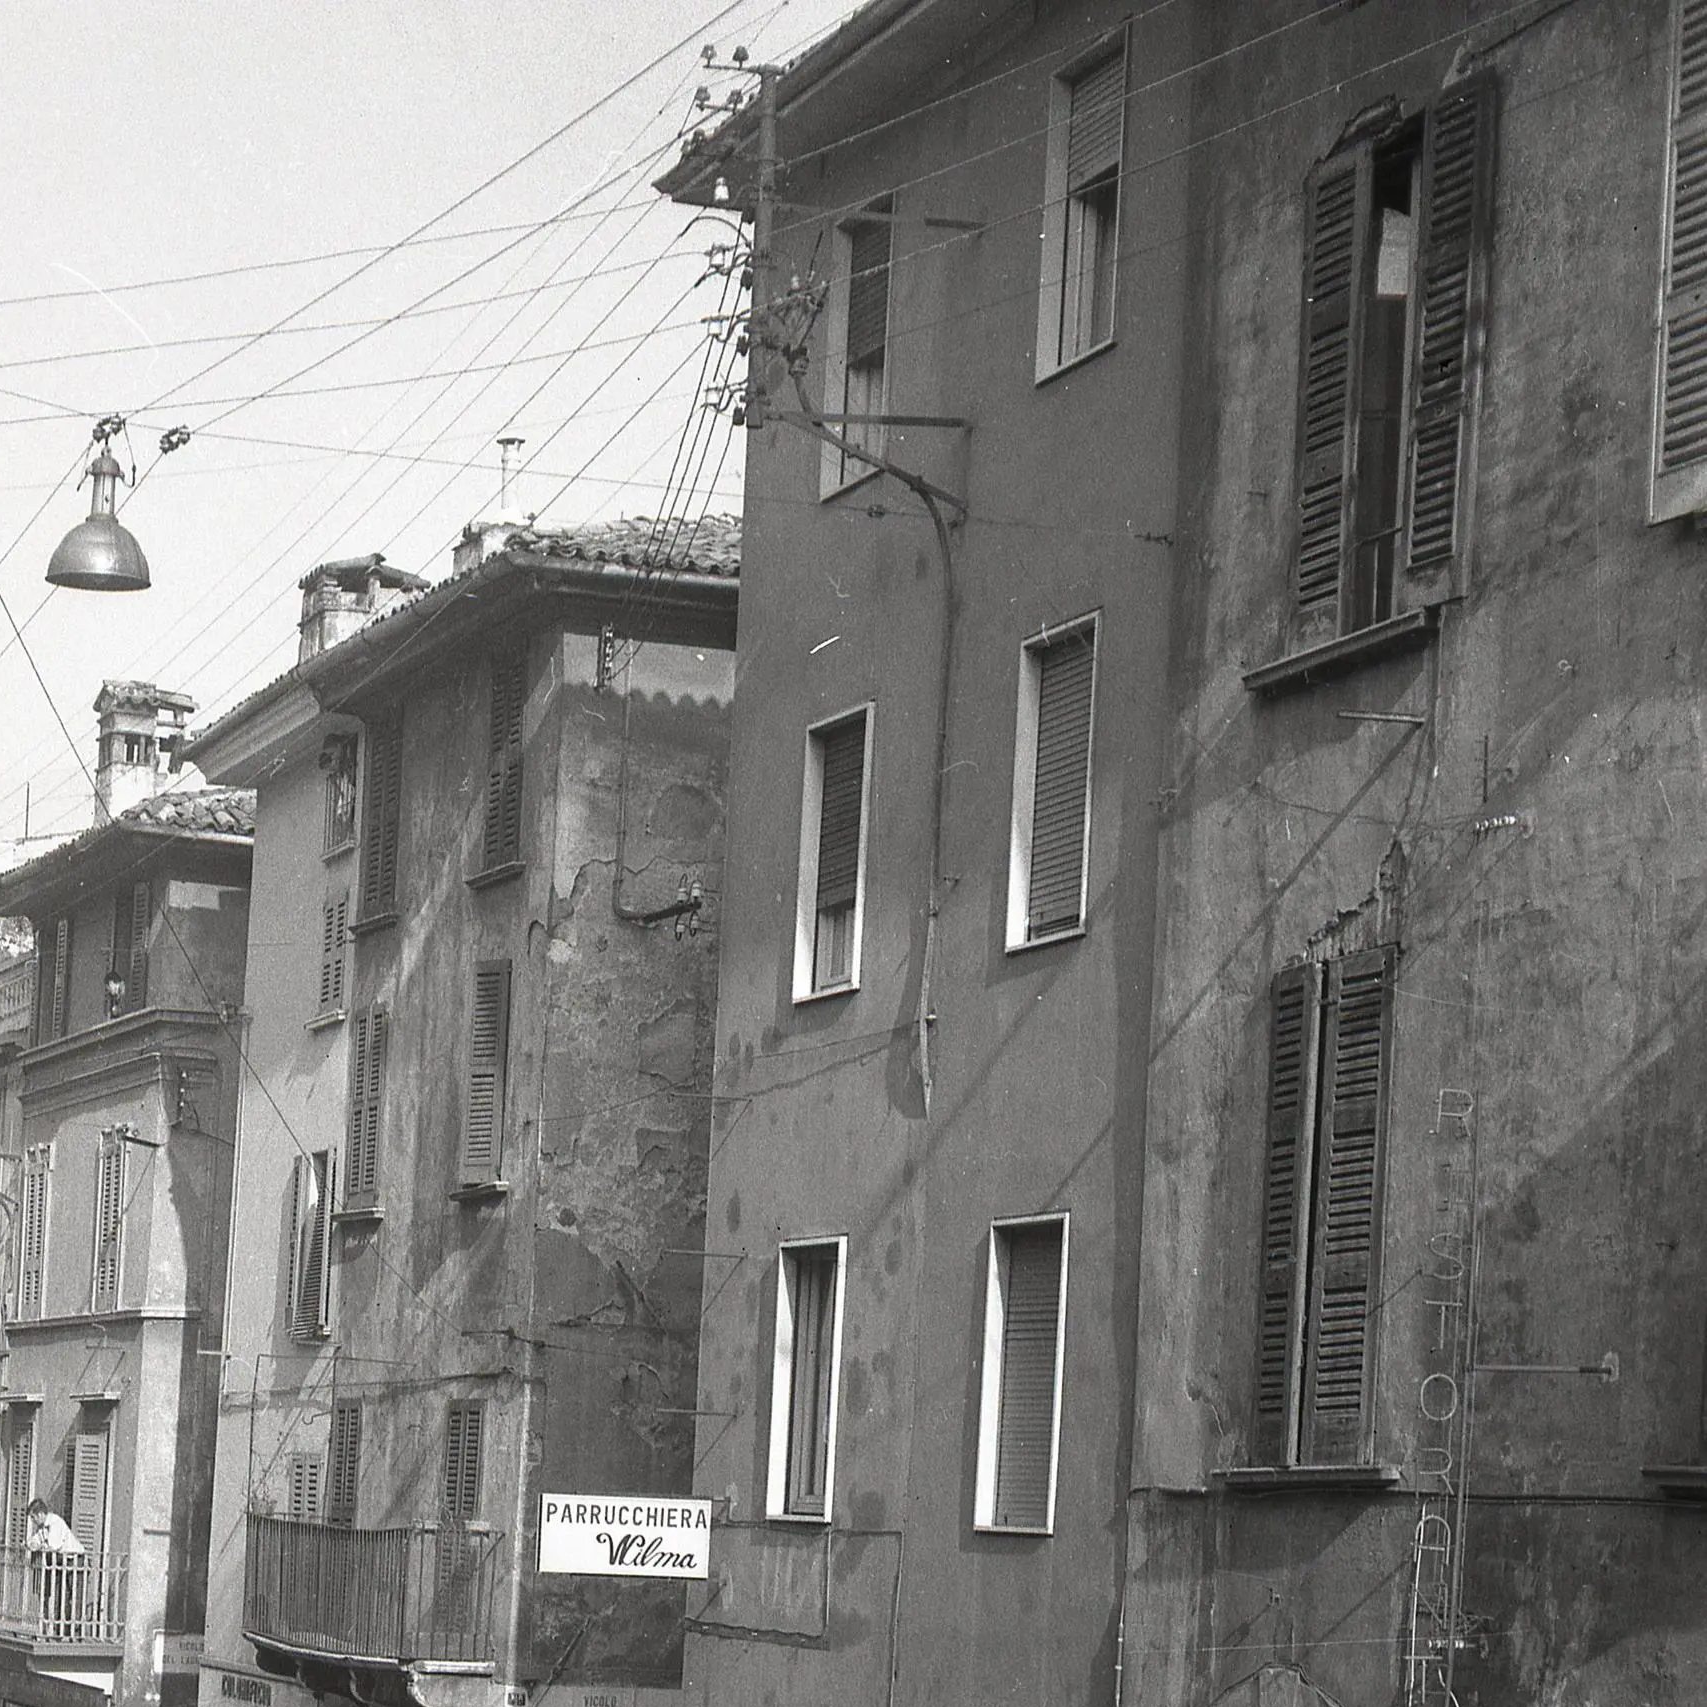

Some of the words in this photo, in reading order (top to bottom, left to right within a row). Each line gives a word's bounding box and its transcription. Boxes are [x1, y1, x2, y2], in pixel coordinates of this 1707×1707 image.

[546, 1502, 708, 1529] PARRUCCHIERA
[596, 1532, 698, 1568] Wilma
[584, 1695, 617, 1707] VICOLO
